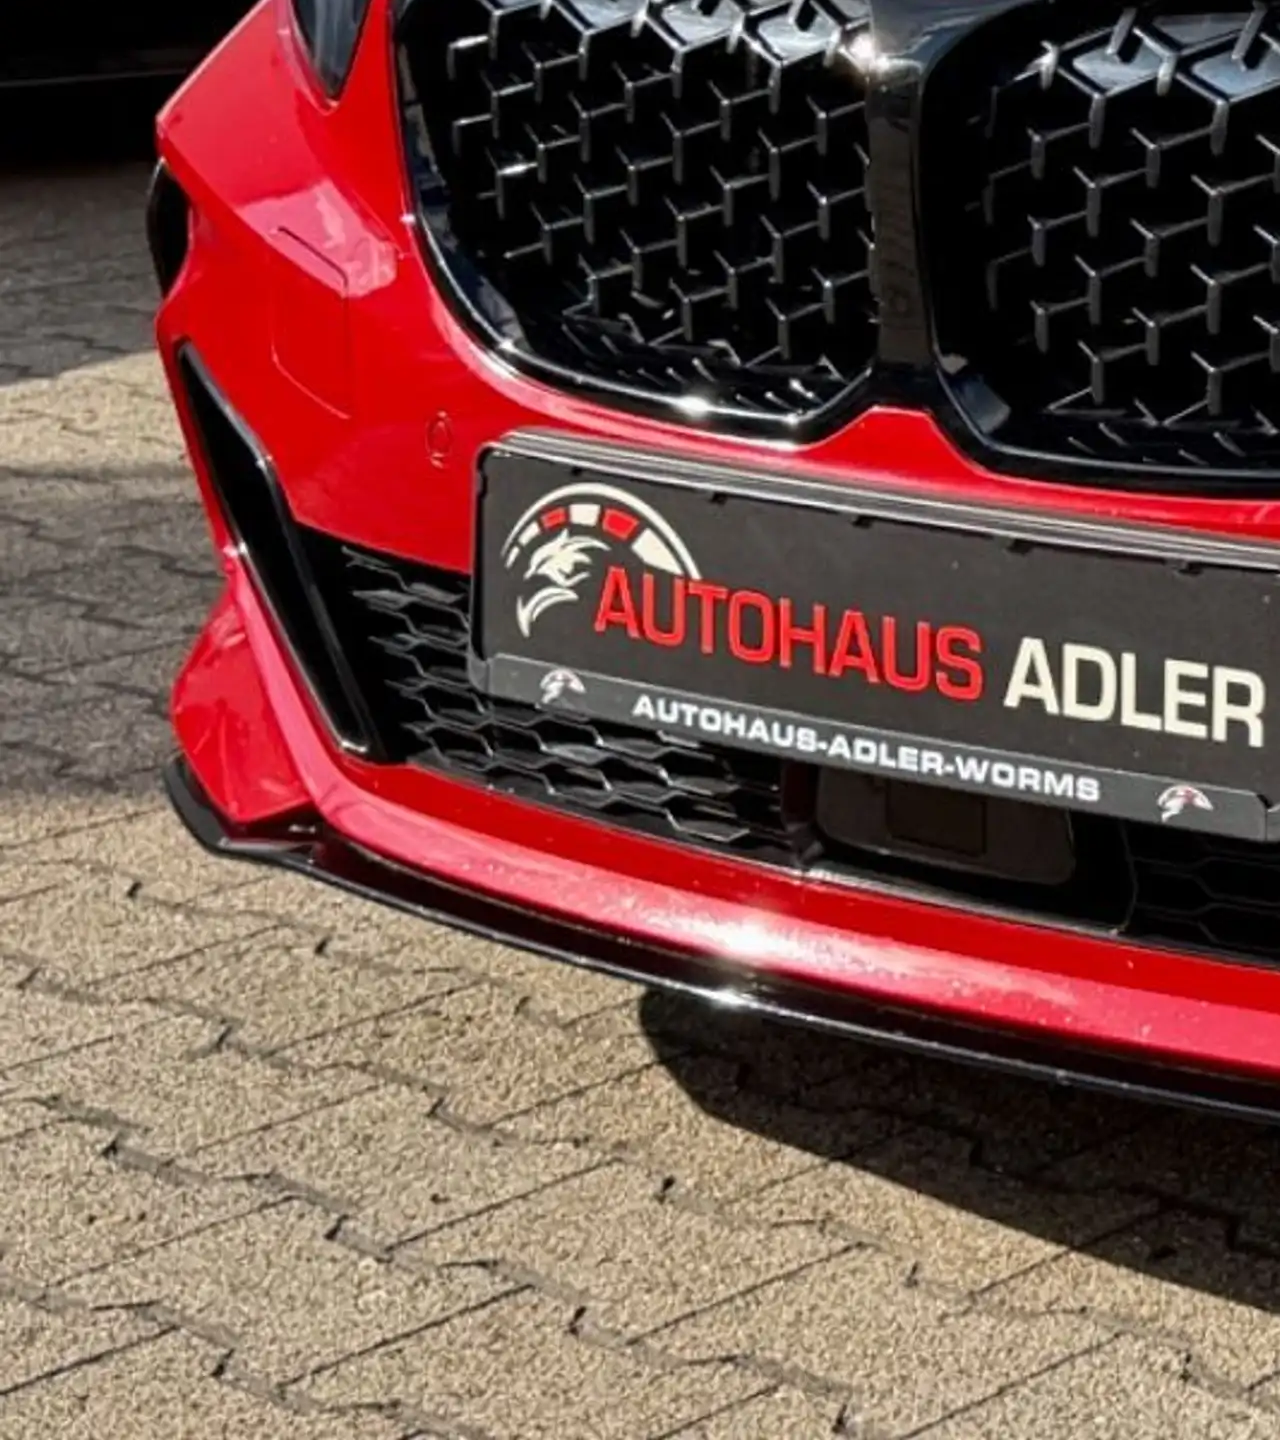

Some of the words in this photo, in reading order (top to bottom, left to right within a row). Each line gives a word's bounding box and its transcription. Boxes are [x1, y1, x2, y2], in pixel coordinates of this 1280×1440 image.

[594, 565, 983, 702] AUTOHAUS
[1003, 637, 1266, 749] ADLER
[632, 694, 1101, 803] AUTOHAUS-ADLER-WORMS
